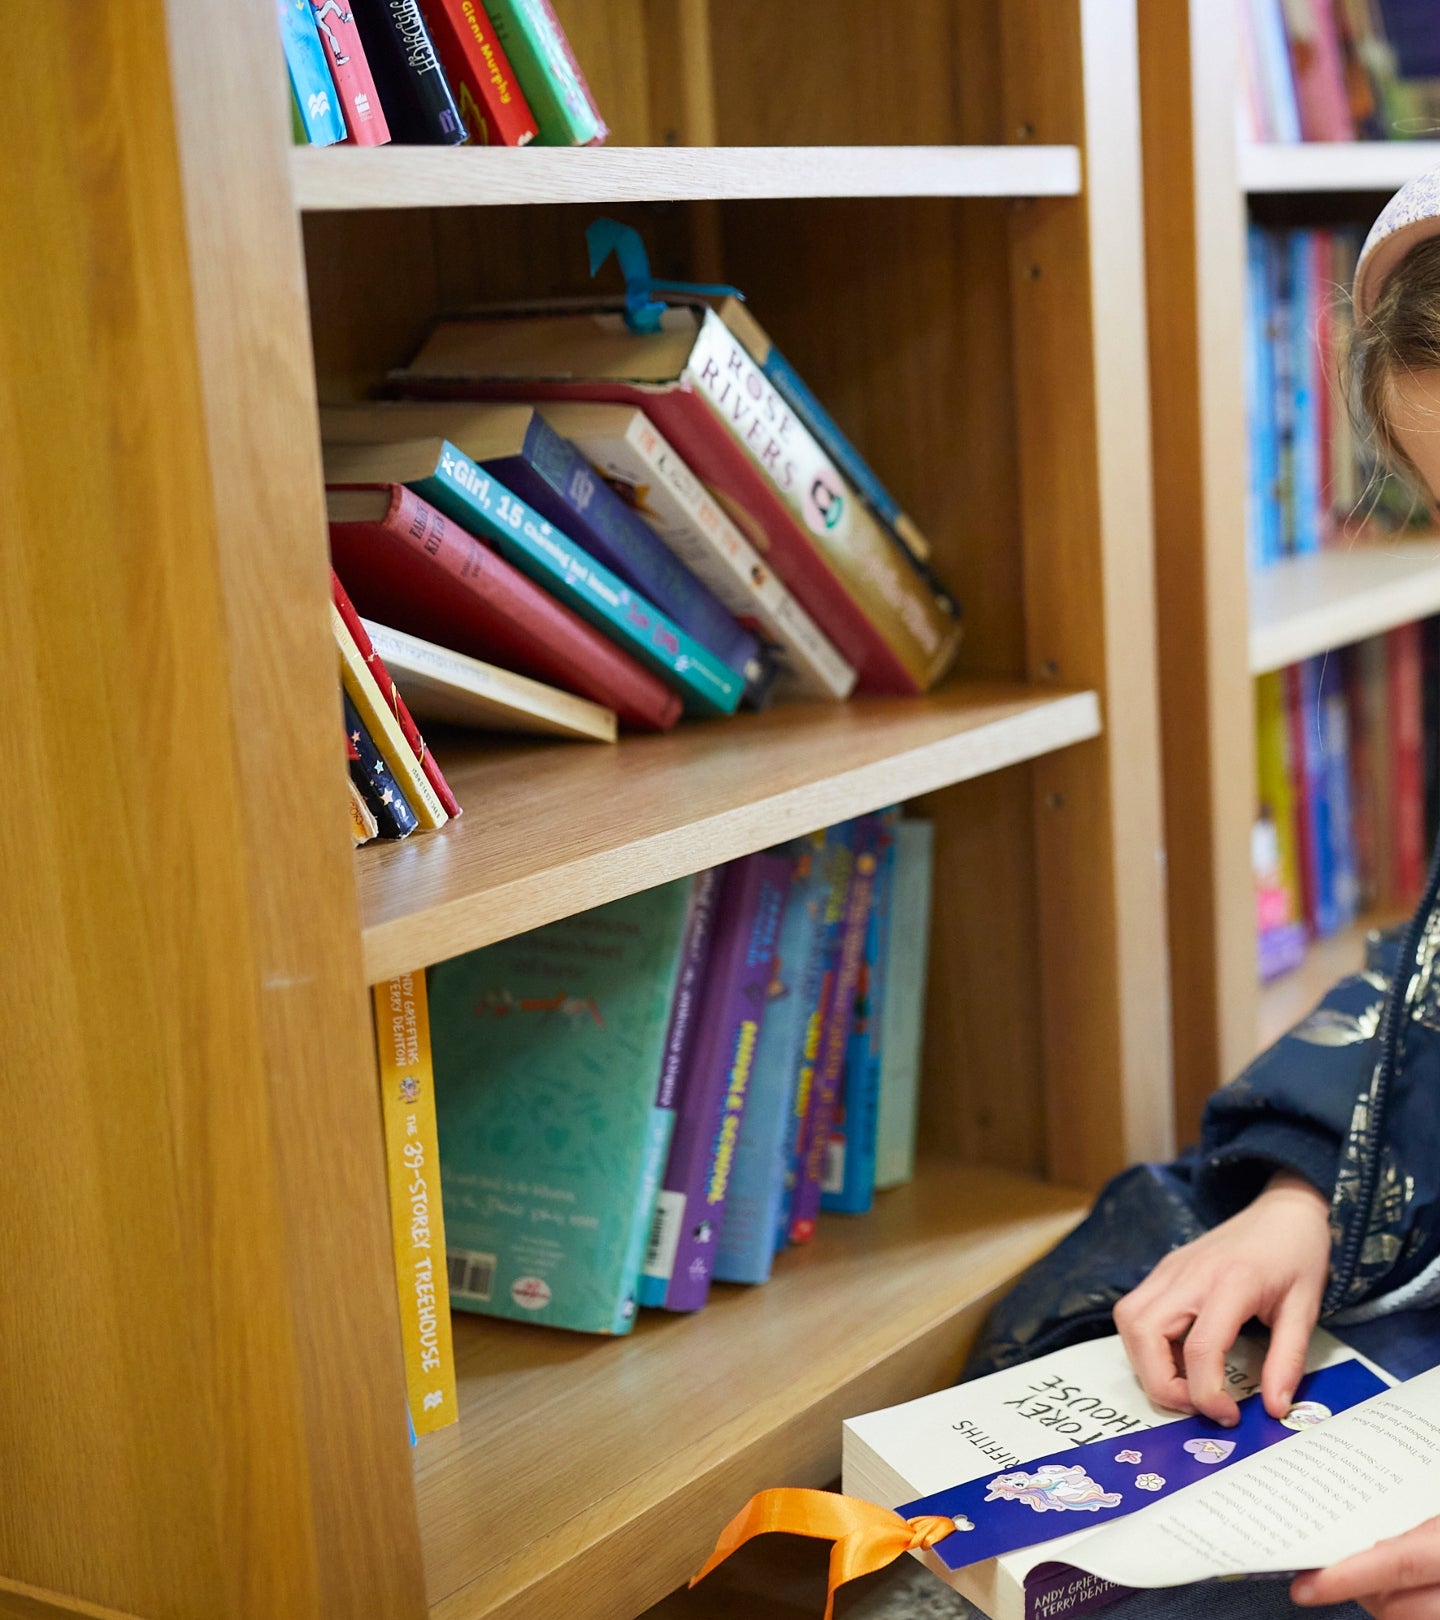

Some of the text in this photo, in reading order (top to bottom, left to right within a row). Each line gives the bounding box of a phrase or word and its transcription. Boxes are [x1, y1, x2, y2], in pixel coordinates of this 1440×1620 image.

[390, 0, 441, 76] ARDAGH
[461, 0, 511, 104] Glenn Murphy
[701, 357, 799, 490] RIVERS
[451, 458, 492, 508] Girl,
[494, 491, 525, 530] 15
[388, 977, 406, 1066] TERRY DENTON
[400, 972, 419, 1065] NDY GRIFFITHS
[402, 1114, 441, 1373] THE 39-STOREY TREEHOUSE
[1382, 1429, 1418, 1456] Treehouse
[1400, 1423, 1436, 1449] Treehouse
[1417, 1452, 1432, 1466] The
[1032, 1572, 1104, 1609] ANDY GRIFF
[1041, 1579, 1117, 1617] TERRY DENTO
